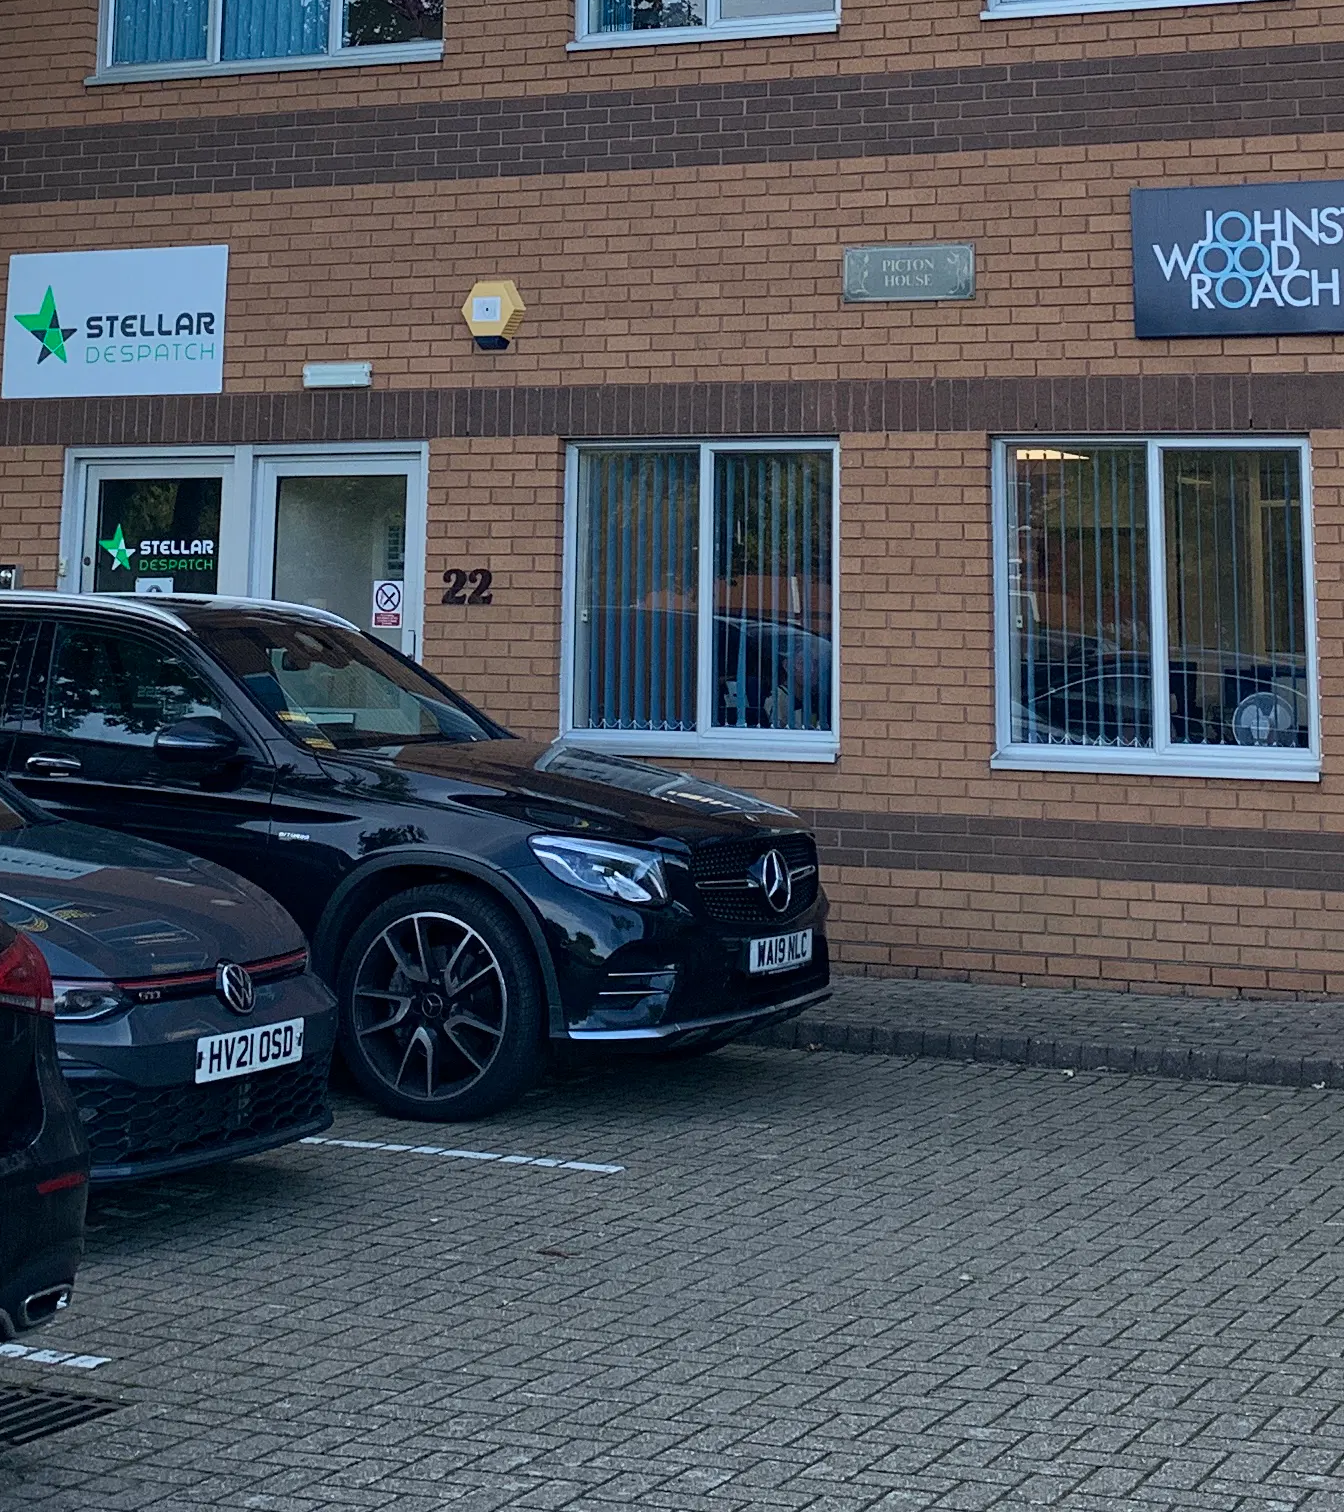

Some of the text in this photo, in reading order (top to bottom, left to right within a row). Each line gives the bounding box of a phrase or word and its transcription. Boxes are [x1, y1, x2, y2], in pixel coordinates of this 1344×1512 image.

[882, 258, 935, 272] PICTON
[1152, 240, 1301, 282] WOOD
[884, 273, 933, 287] HOUSE
[1190, 268, 1340, 310] ROACH
[86, 312, 215, 339] STELLAR
[86, 342, 215, 364] DESPATCH
[140, 540, 214, 555] STELLAR
[139, 559, 213, 570] DESPATCH
[441, 568, 493, 605] 22
[208, 1025, 294, 1074] HV21 OSD
